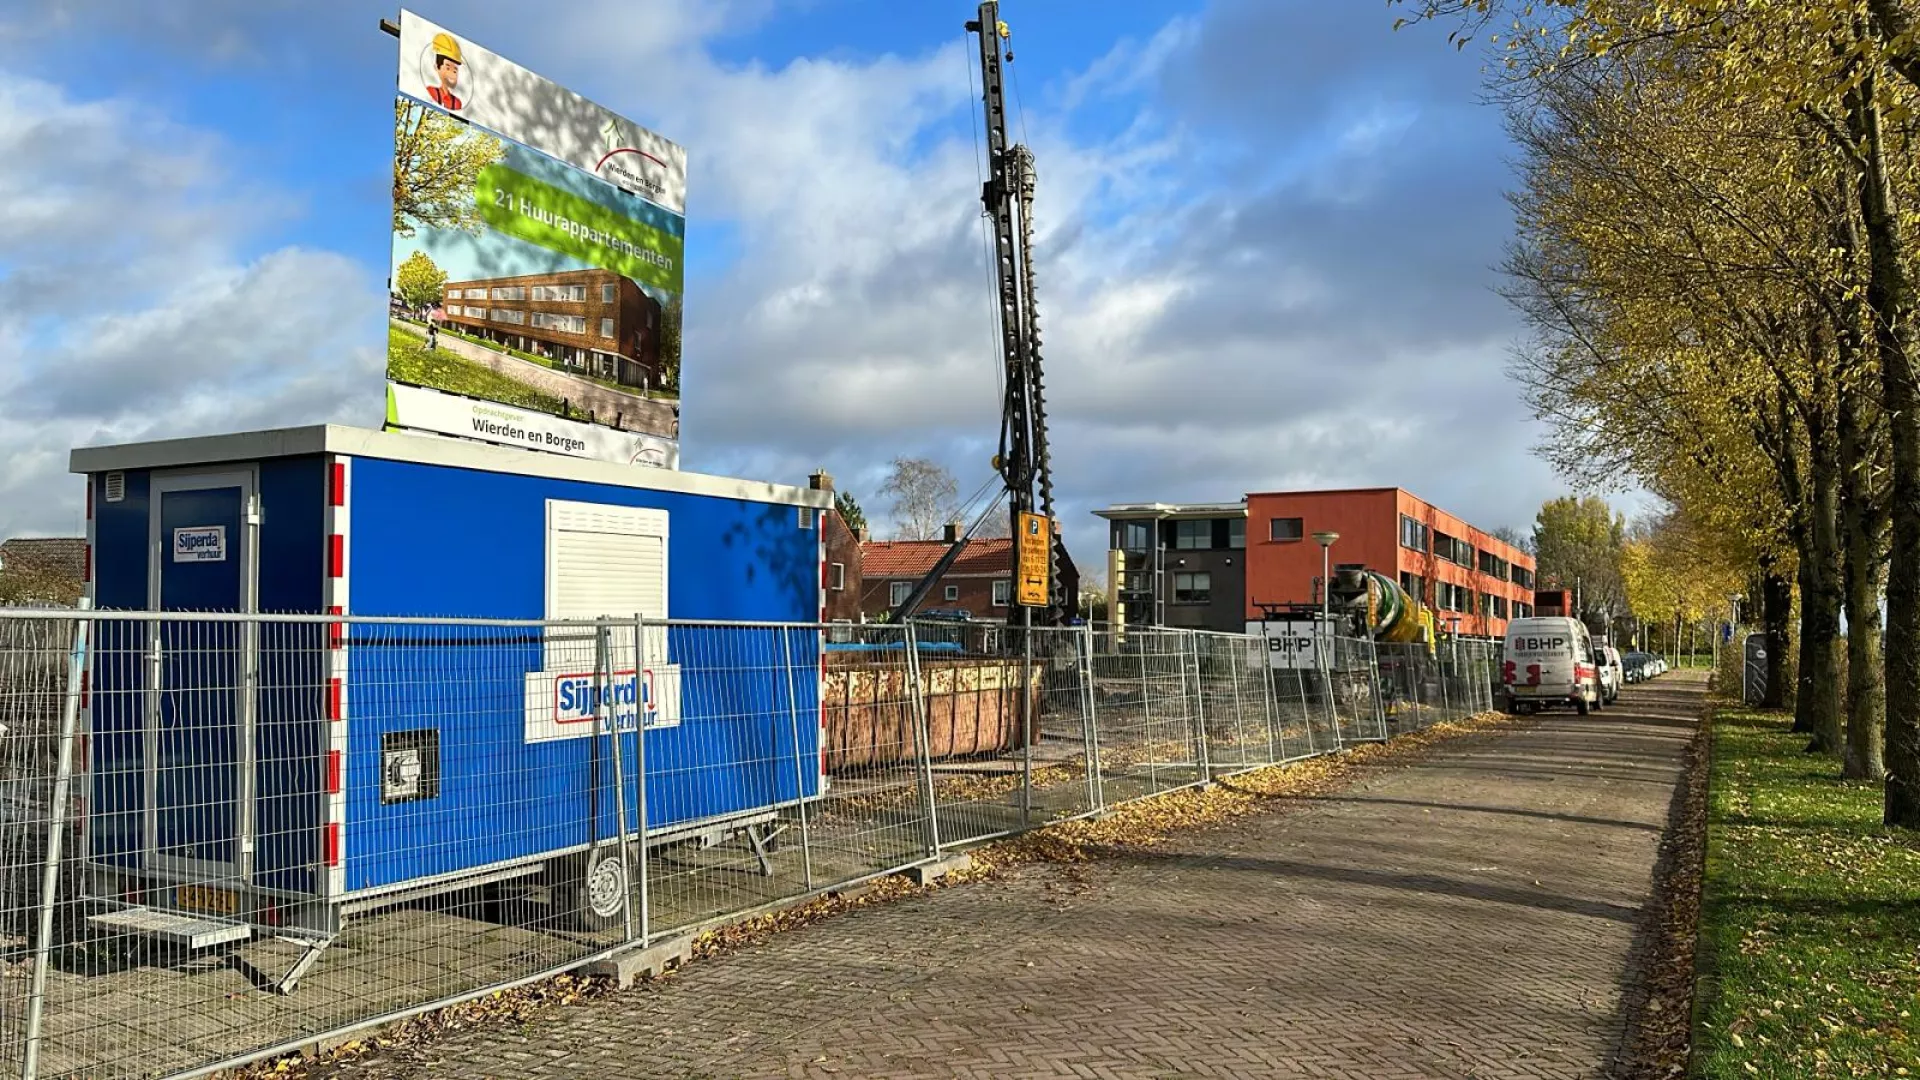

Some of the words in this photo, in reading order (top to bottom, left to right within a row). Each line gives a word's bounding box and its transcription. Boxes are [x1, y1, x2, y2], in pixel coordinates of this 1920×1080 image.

[495, 188, 513, 211] 21
[520, 197, 673, 271] Huurappartementen
[472, 405, 524, 421] Opdrachtgever
[472, 417, 524, 440] Wierden
[527, 430, 542, 443] en
[545, 432, 585, 451] Borgen
[179, 532, 218, 551] Sijperda
[1269, 637, 1312, 652] BHP
[1527, 637, 1564, 650] BHP
